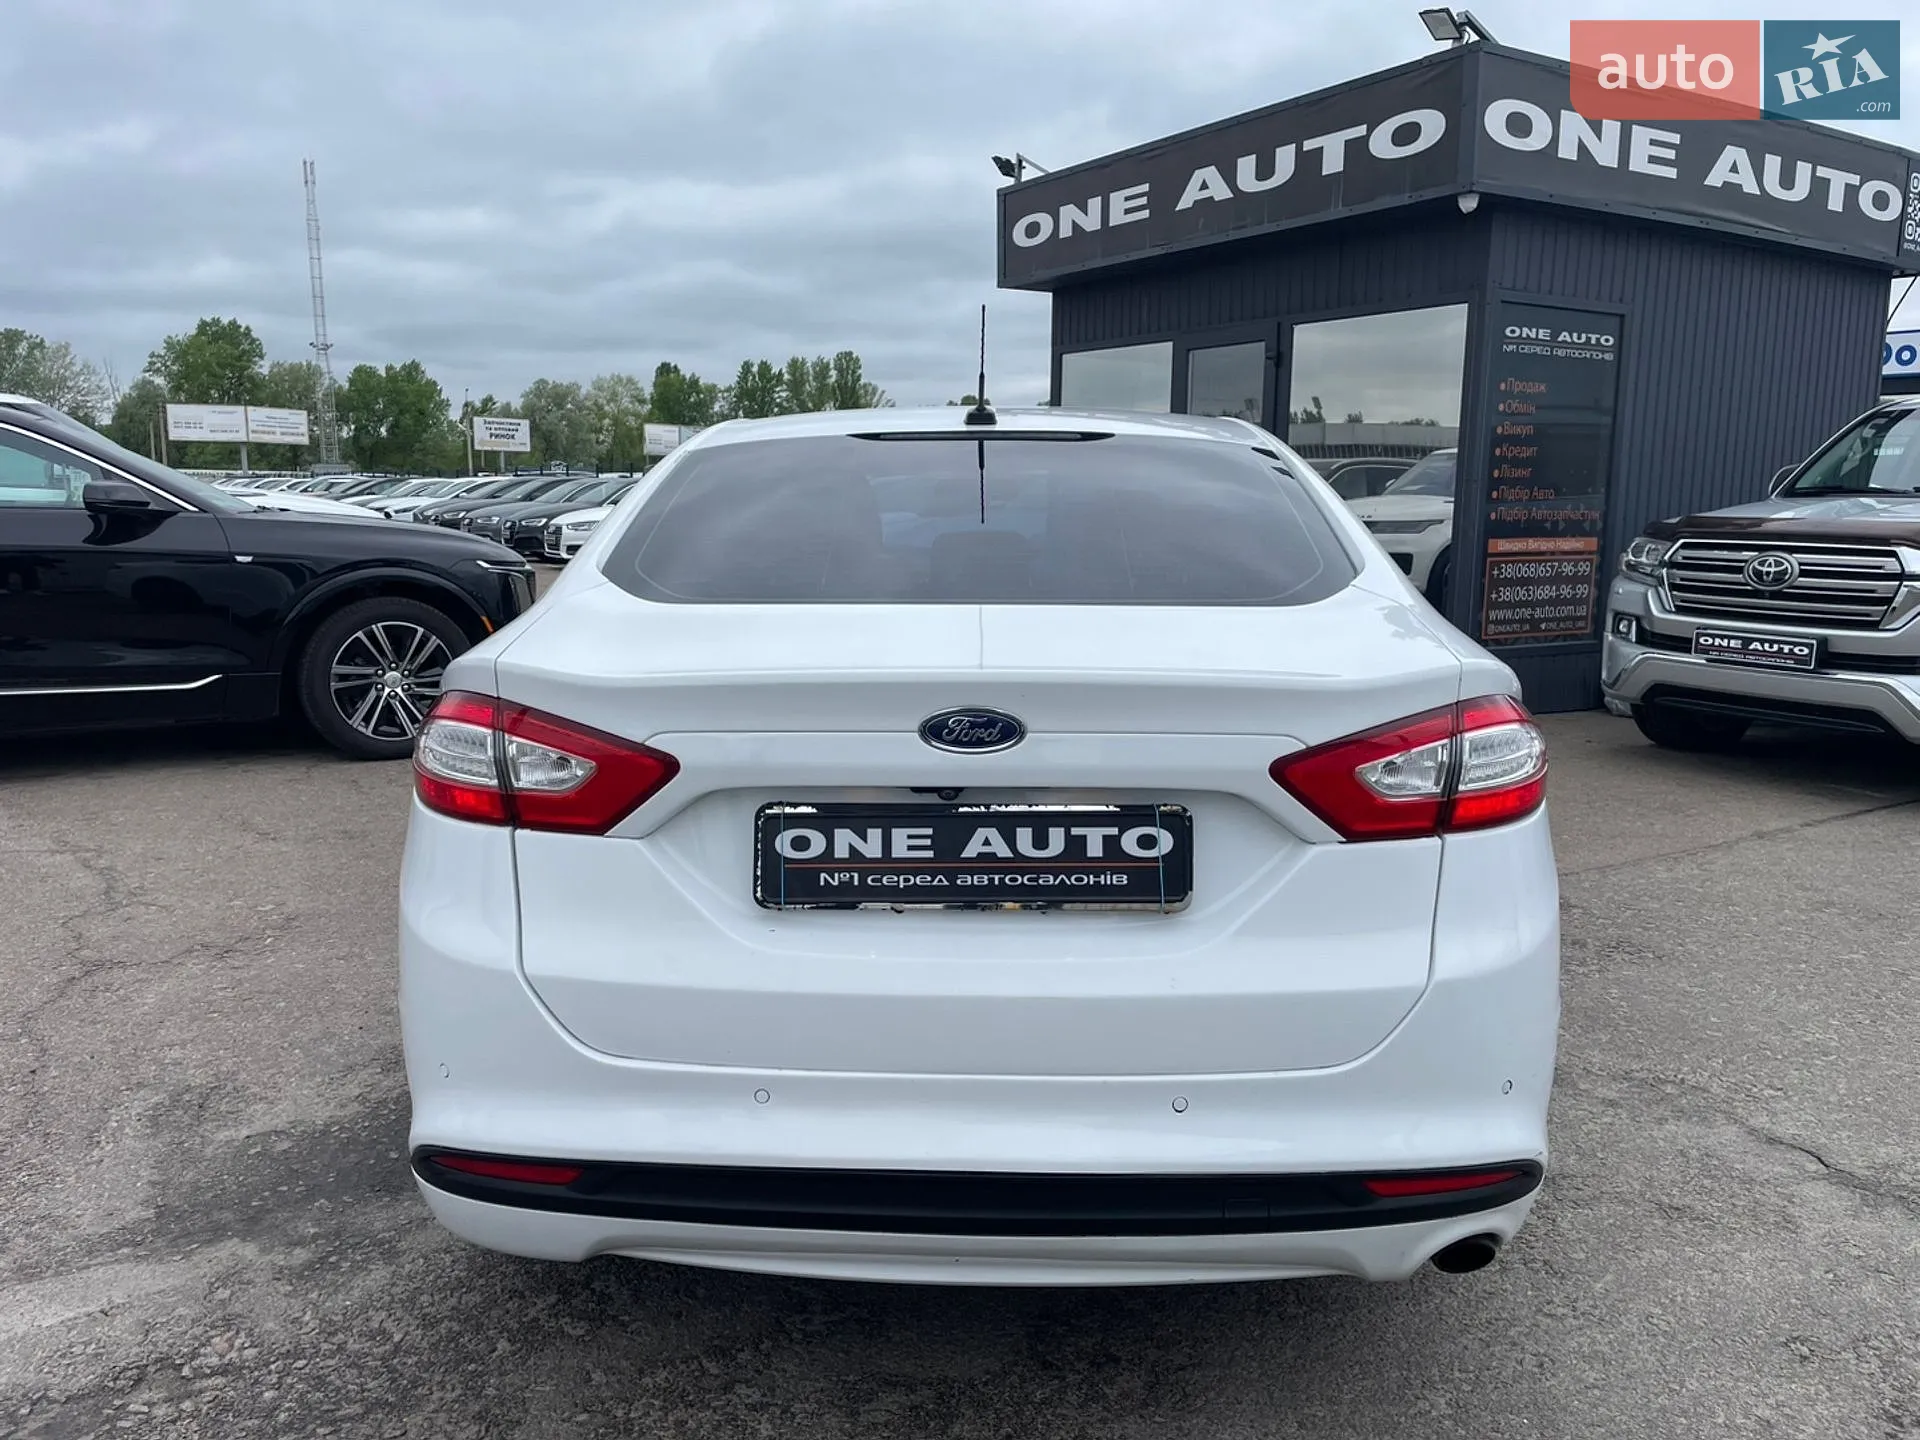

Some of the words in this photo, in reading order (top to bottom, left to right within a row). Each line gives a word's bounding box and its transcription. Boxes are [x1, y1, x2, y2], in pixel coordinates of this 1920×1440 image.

[1483, 98, 1681, 180] ONE
[1703, 145, 1903, 222] AUTO
[1011, 182, 1150, 248] ONE
[1174, 108, 1447, 212] AUTO
[1504, 326, 1552, 340] ONE
[1557, 331, 1615, 346] AUTO
[1506, 377, 1547, 394] Продаж
[1505, 399, 1536, 414] Обмін
[1503, 421, 1534, 438] Викуп
[1501, 443, 1538, 460] Кредит
[1500, 464, 1532, 478] Лізинг
[1498, 485, 1530, 501] Підбір
[1532, 486, 1555, 500] Авто
[1496, 506, 1528, 522] Підбір
[1492, 561, 1591, 580] +38(068)657-96-99
[1490, 584, 1589, 603] +38(063)684-96-99
[1488, 605, 1587, 621] www.one-auto.com.ua
[1699, 636, 1742, 648] ONE
[1748, 641, 1810, 655] AUTO
[942, 716, 1003, 742] Ford
[774, 827, 935, 860] ONE
[960, 826, 1175, 858] AUTO
[866, 873, 950, 889] серед
[955, 871, 1128, 886] автосалонів
